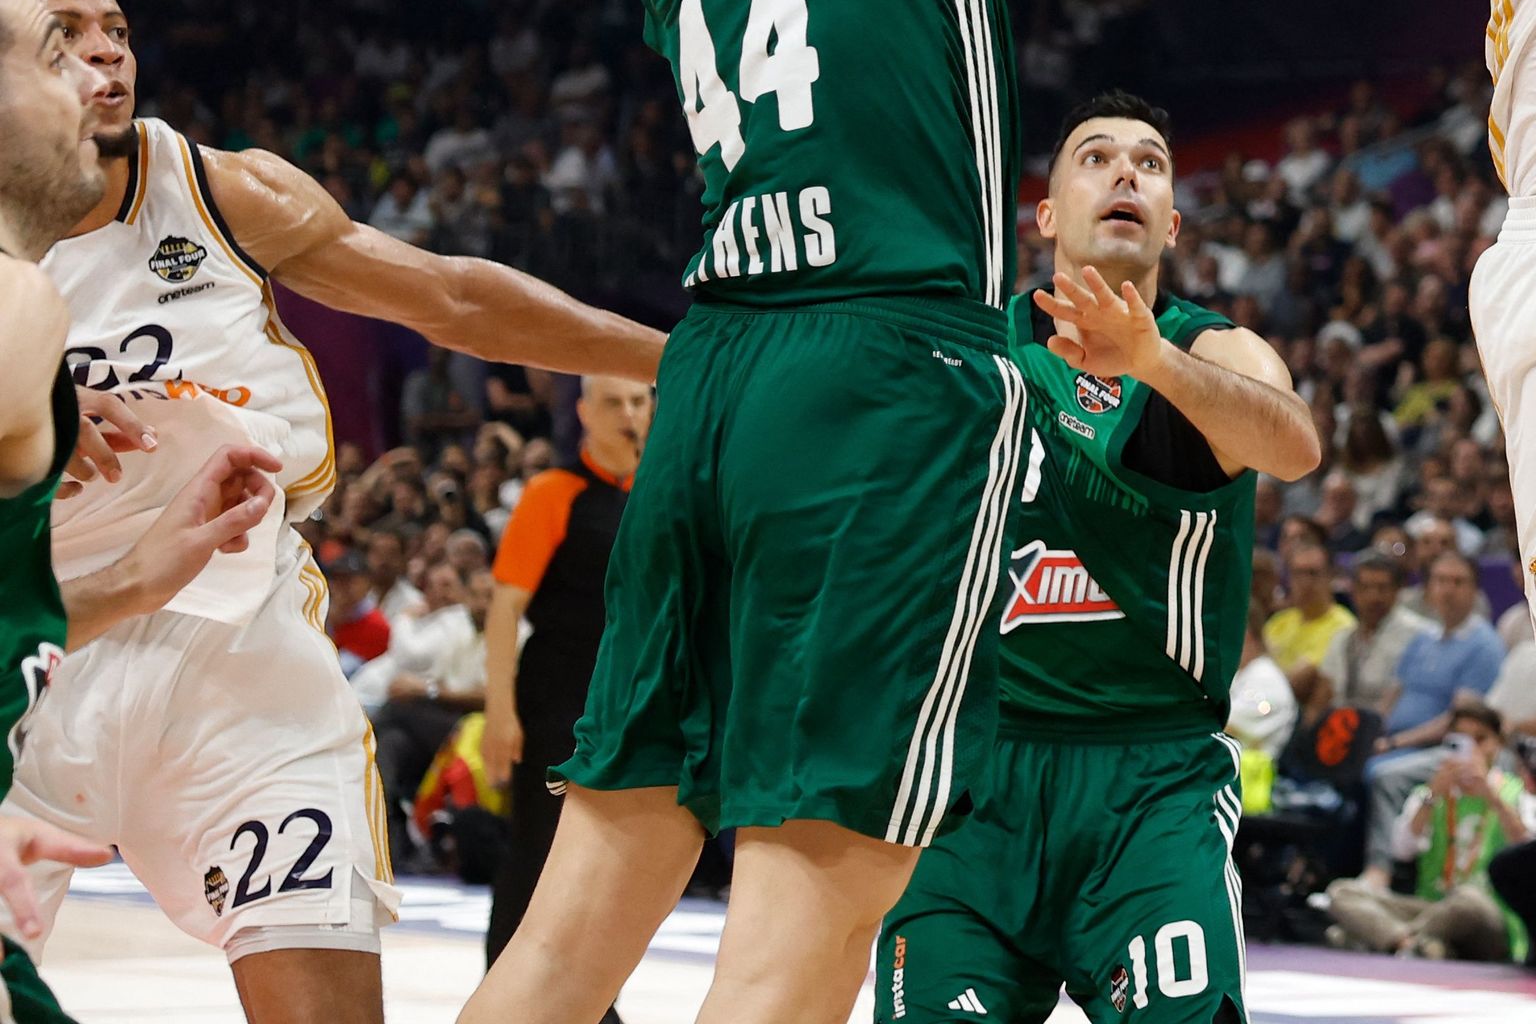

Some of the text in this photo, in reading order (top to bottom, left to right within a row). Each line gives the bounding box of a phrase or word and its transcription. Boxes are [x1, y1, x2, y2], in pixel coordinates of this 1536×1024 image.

[150, 249, 206, 270] FINAL FOUR
[230, 808, 333, 909] 22
[891, 935, 907, 1019] instacar
[1128, 920, 1209, 1009] 10
